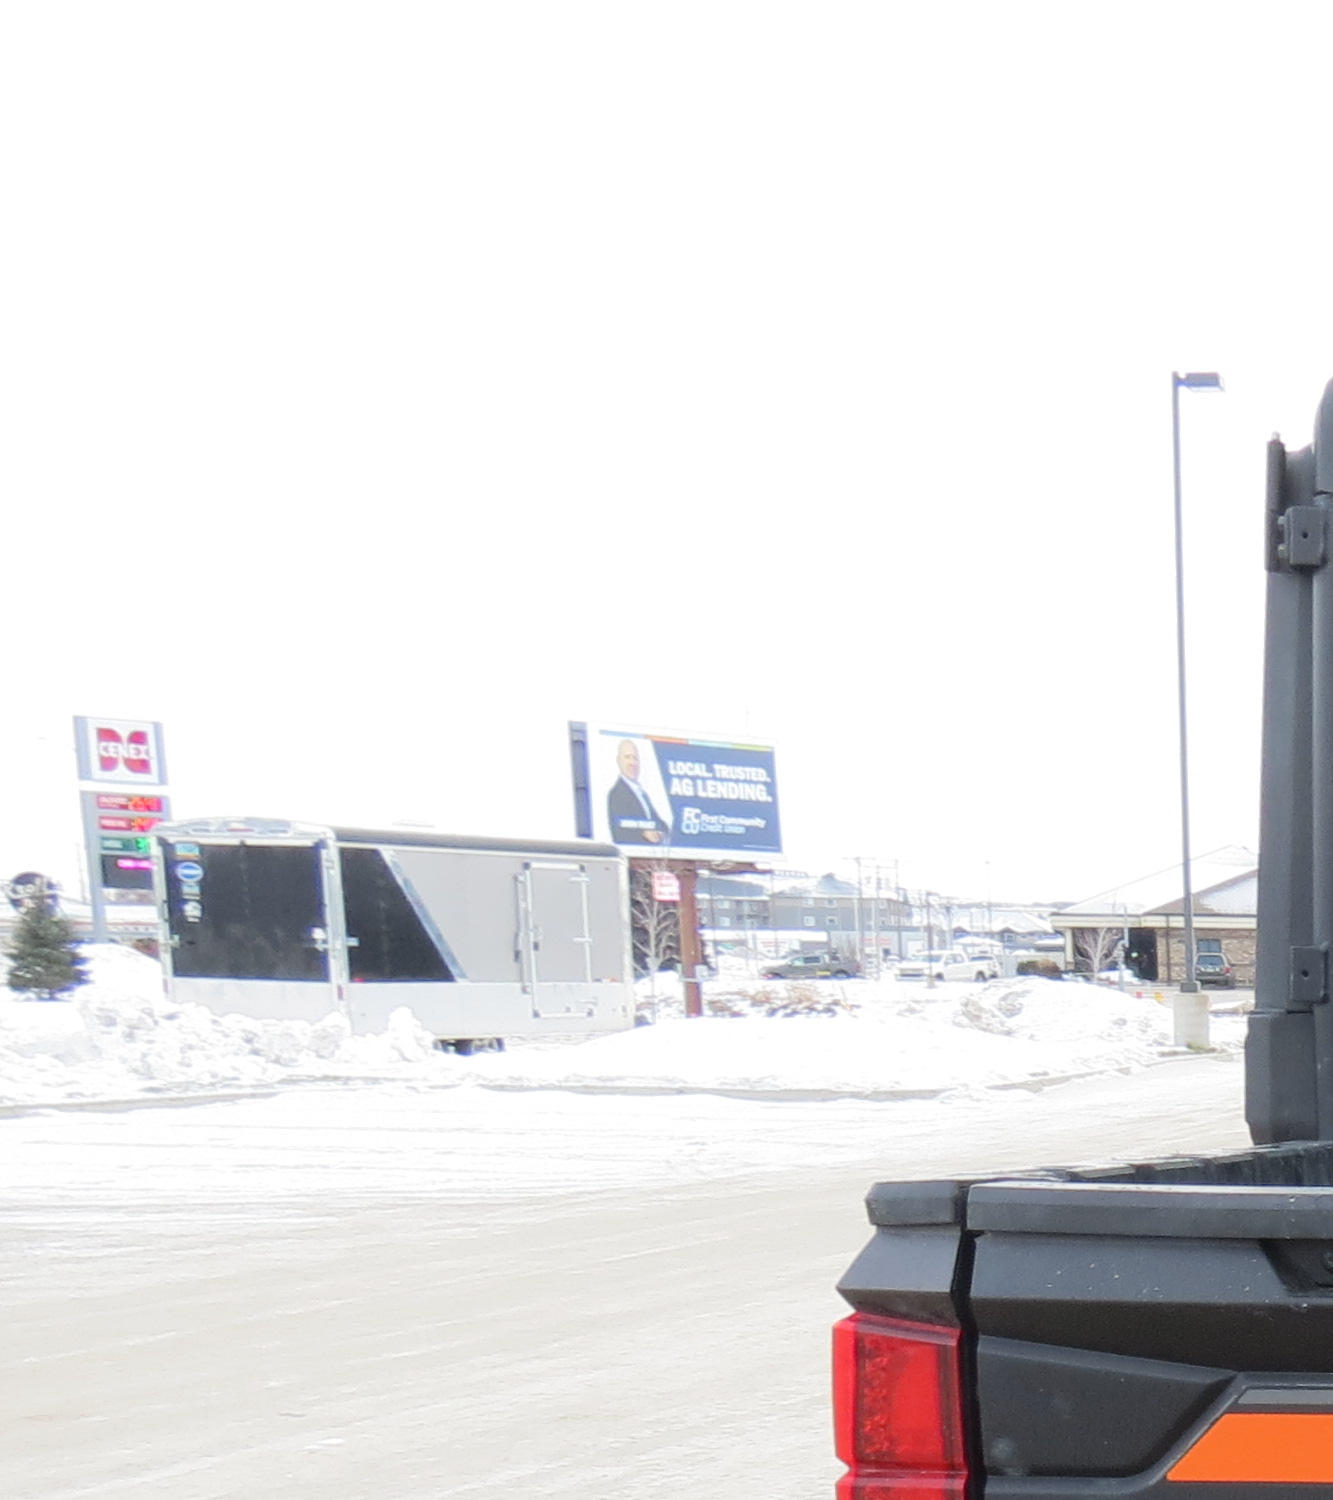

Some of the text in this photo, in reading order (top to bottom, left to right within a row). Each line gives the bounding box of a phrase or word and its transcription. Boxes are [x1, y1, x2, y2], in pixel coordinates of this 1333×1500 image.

[99, 741, 152, 760] CENEX
[668, 760, 771, 783] LOCAL. TRUSTED.
[670, 777, 773, 802] AG LENDING.
